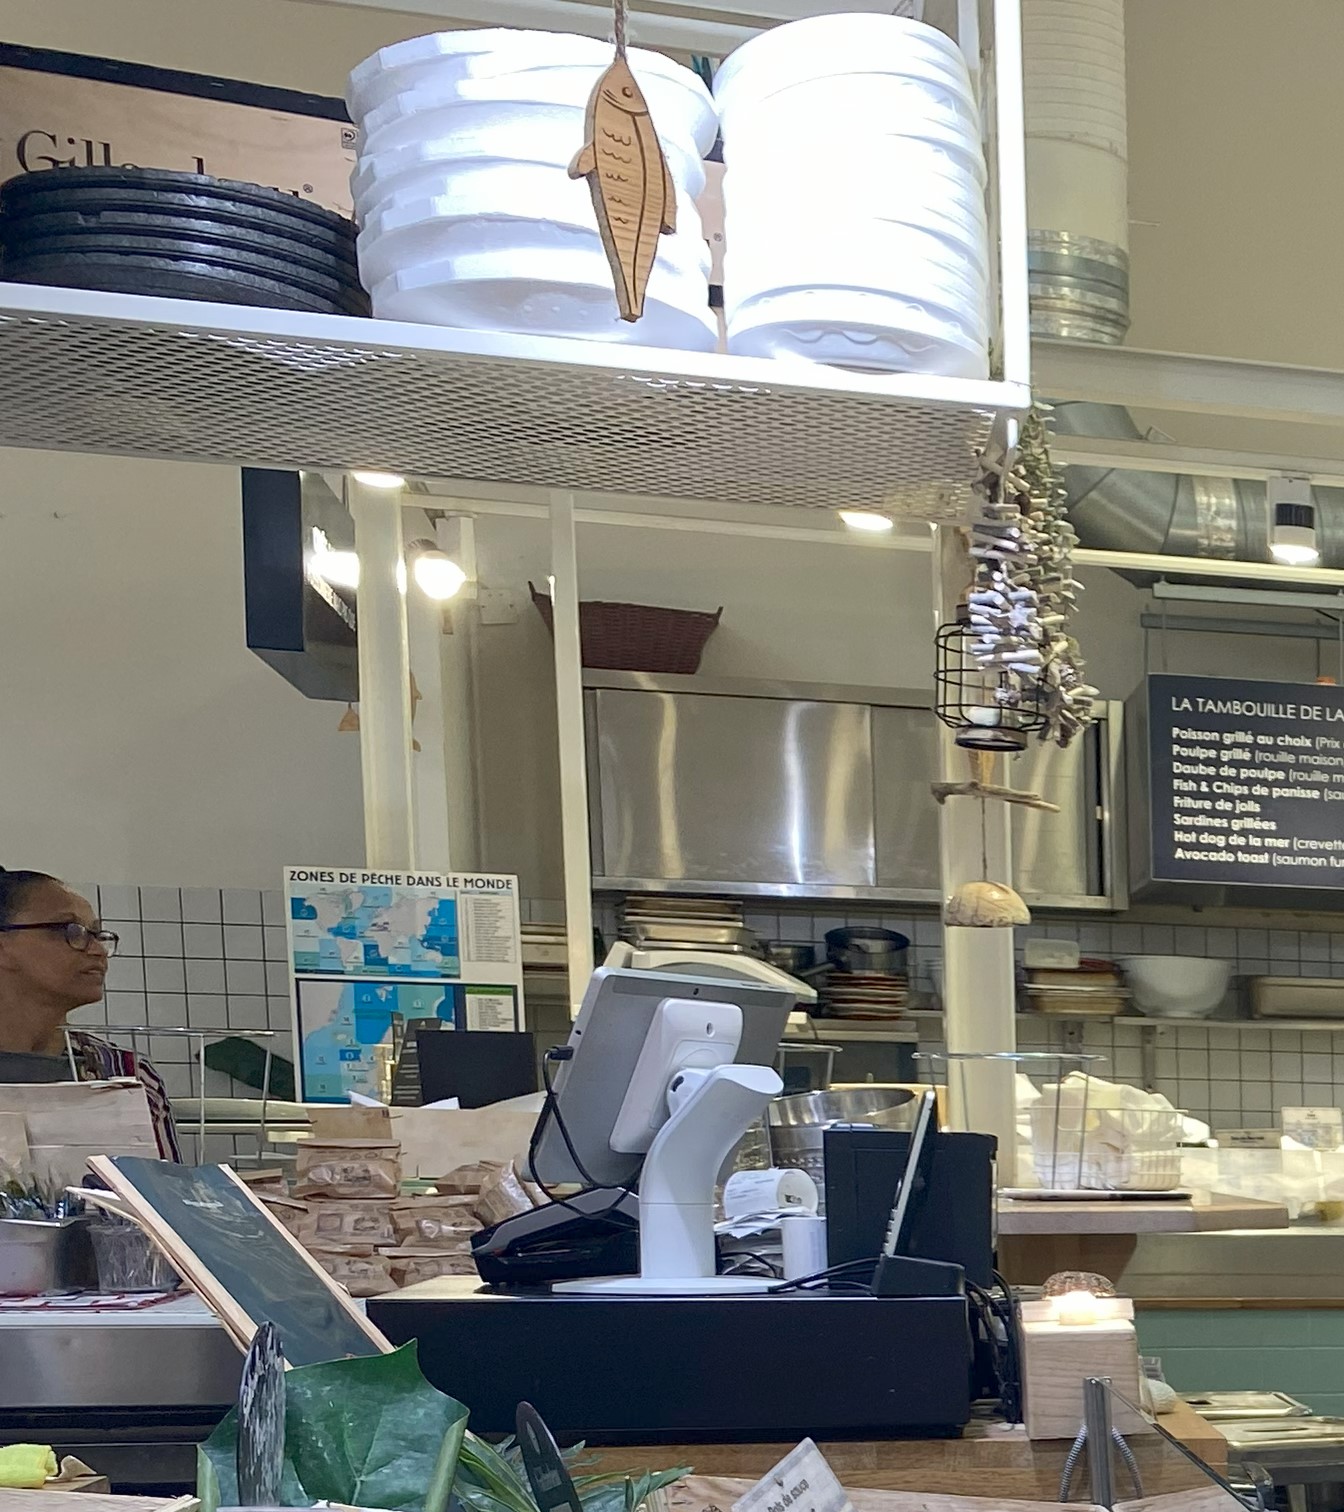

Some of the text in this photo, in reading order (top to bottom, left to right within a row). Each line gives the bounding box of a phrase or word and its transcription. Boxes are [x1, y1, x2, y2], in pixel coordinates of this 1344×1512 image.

[1171, 696, 1192, 712] LA
[1196, 698, 1296, 719] TAMBOUILLE
[1300, 706, 1322, 720] DE
[1172, 727, 1219, 741] Poisson
[1223, 731, 1254, 744] grillé
[1257, 734, 1274, 745] au
[1277, 734, 1312, 747] choix
[1315, 736, 1341, 749] (Prix
[1172, 745, 1217, 760] Poulpe
[1220, 748, 1251, 761] grillé
[1255, 750, 1295, 764] (rouille
[1173, 761, 1216, 776] Daube
[1219, 765, 1236, 777] de
[1240, 767, 1286, 782] poulpe
[1289, 769, 1329, 783] (rouille
[1173, 779, 1197, 792] Fish
[1200, 781, 1209, 793] &
[1213, 781, 1249, 796] Chips
[1252, 784, 1269, 796] de
[1272, 785, 1320, 799] panisse
[1173, 796, 1212, 810] Friture
[1215, 798, 1233, 811] de
[1173, 813, 1277, 830] Sardines grillées
[1174, 831, 1197, 843] Hot
[1199, 832, 1226, 846] dog
[1228, 834, 1246, 846] de
[1249, 835, 1262, 846] la
[1264, 838, 1290, 848] mer
[1175, 847, 1235, 862] Avocado
[1237, 850, 1269, 864] toast
[1273, 853, 1326, 867] (saumon
[289, 871, 513, 890] ZONES DE PÊCHE DANS LE MONDE
